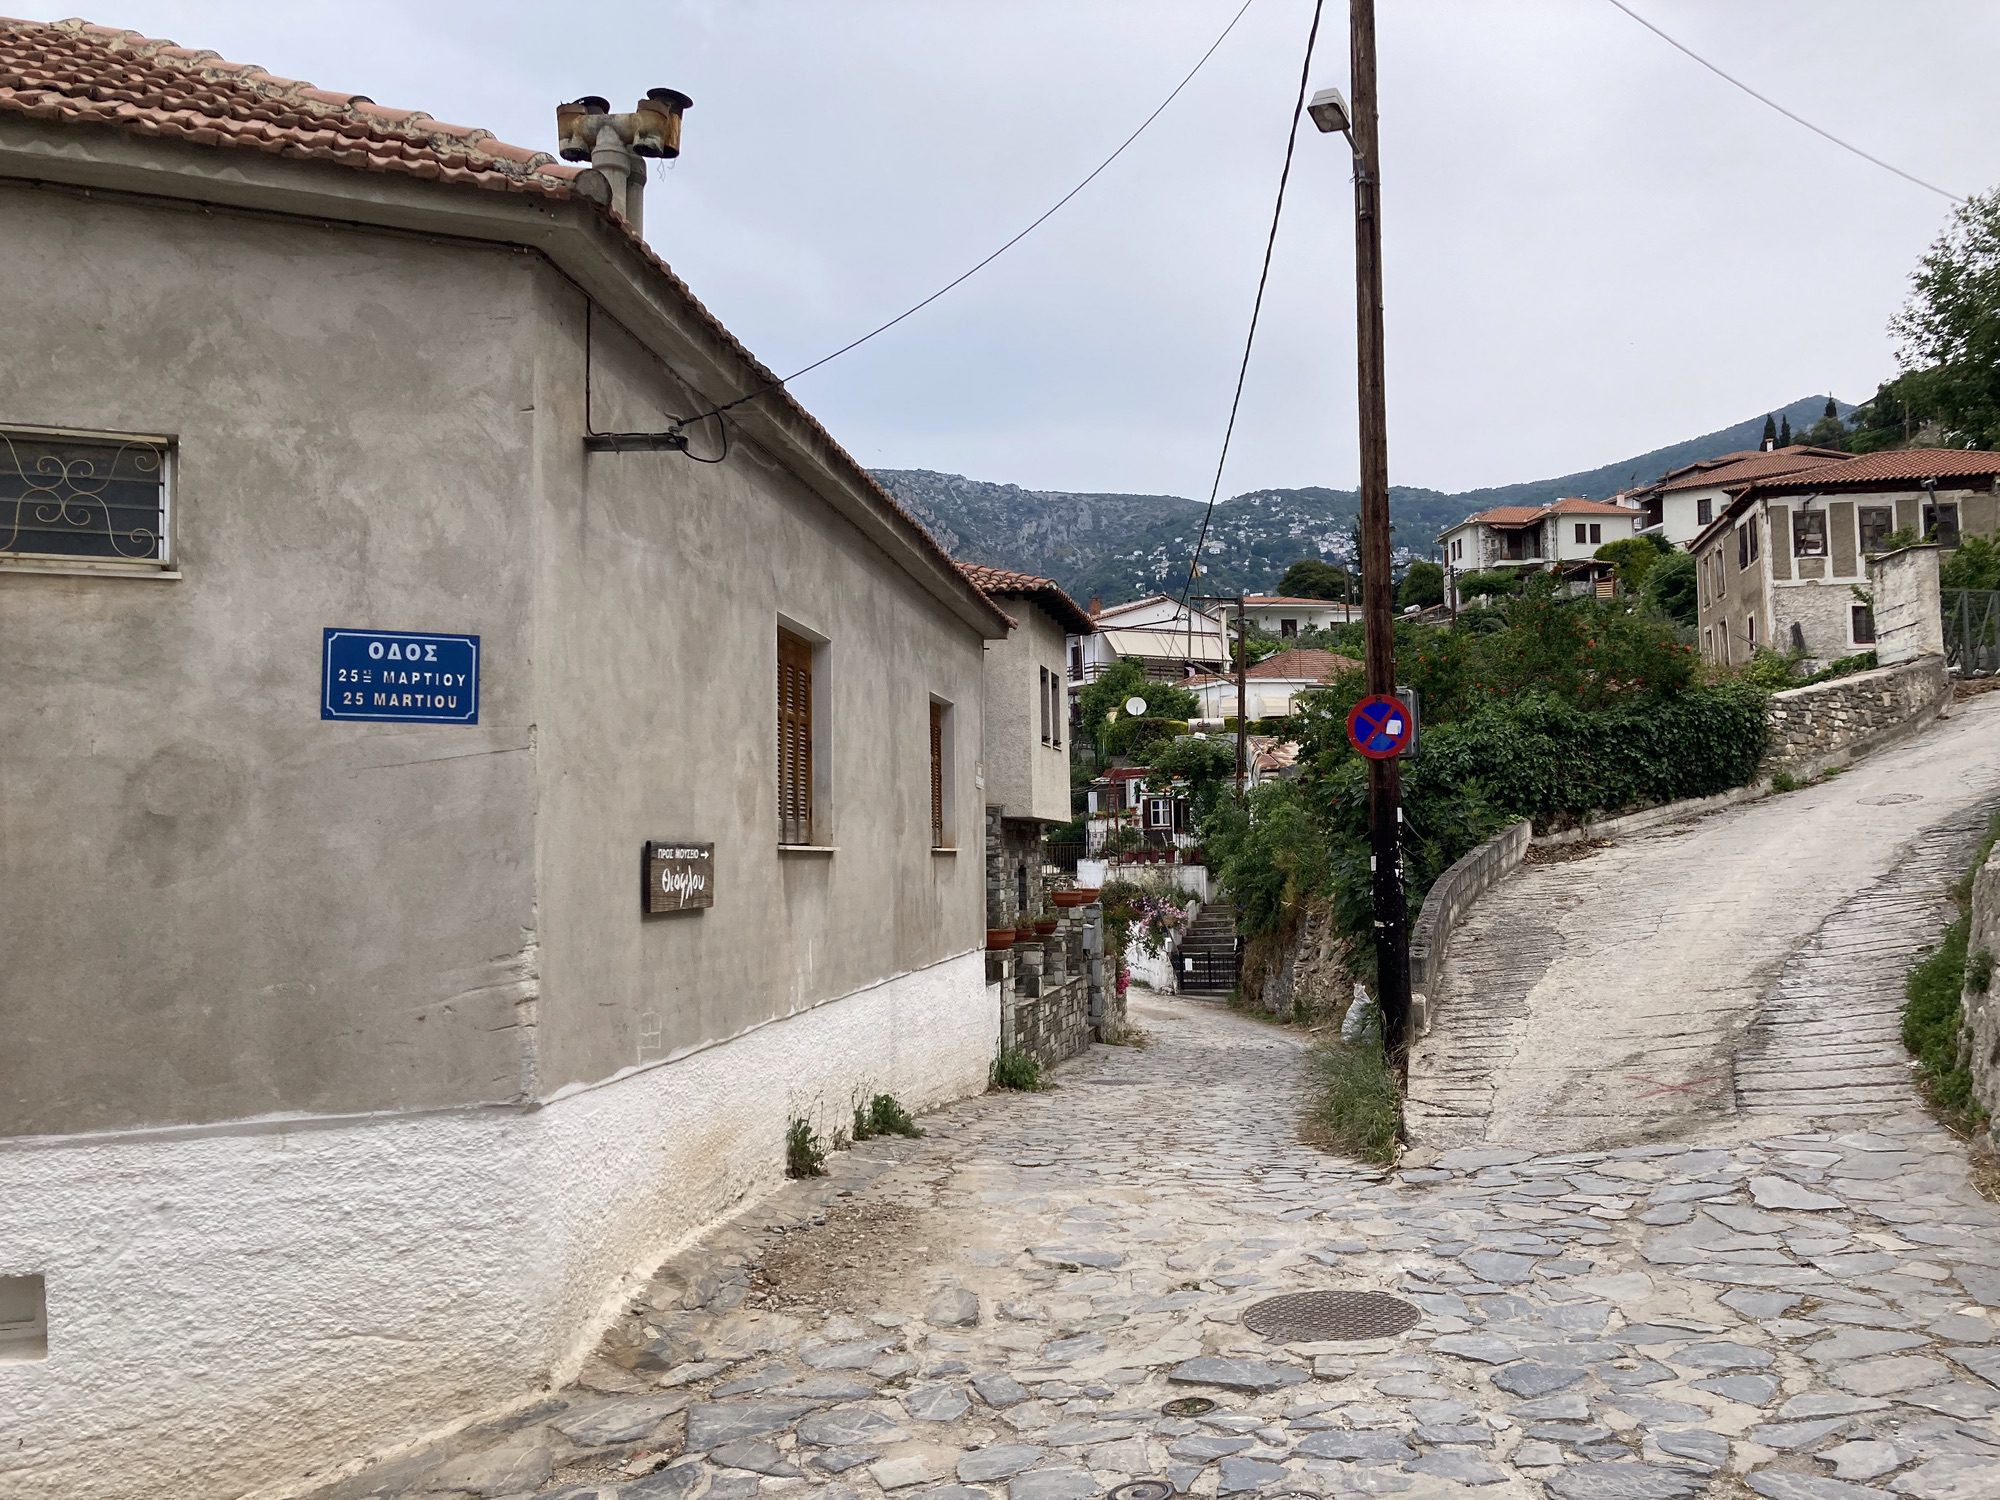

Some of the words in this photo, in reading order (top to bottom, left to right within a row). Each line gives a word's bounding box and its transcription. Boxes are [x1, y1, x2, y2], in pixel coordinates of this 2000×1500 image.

[368, 641, 438, 662] ΟΔΟΣ
[383, 670, 466, 687] ΜΑΡΤΙΟΥ
[343, 691, 364, 706] 25
[373, 692, 458, 709] MARTIOU
[657, 848, 674, 859] ΠΡΟΣ
[675, 848, 699, 859] ΜΟΥΣΕΙΟ
